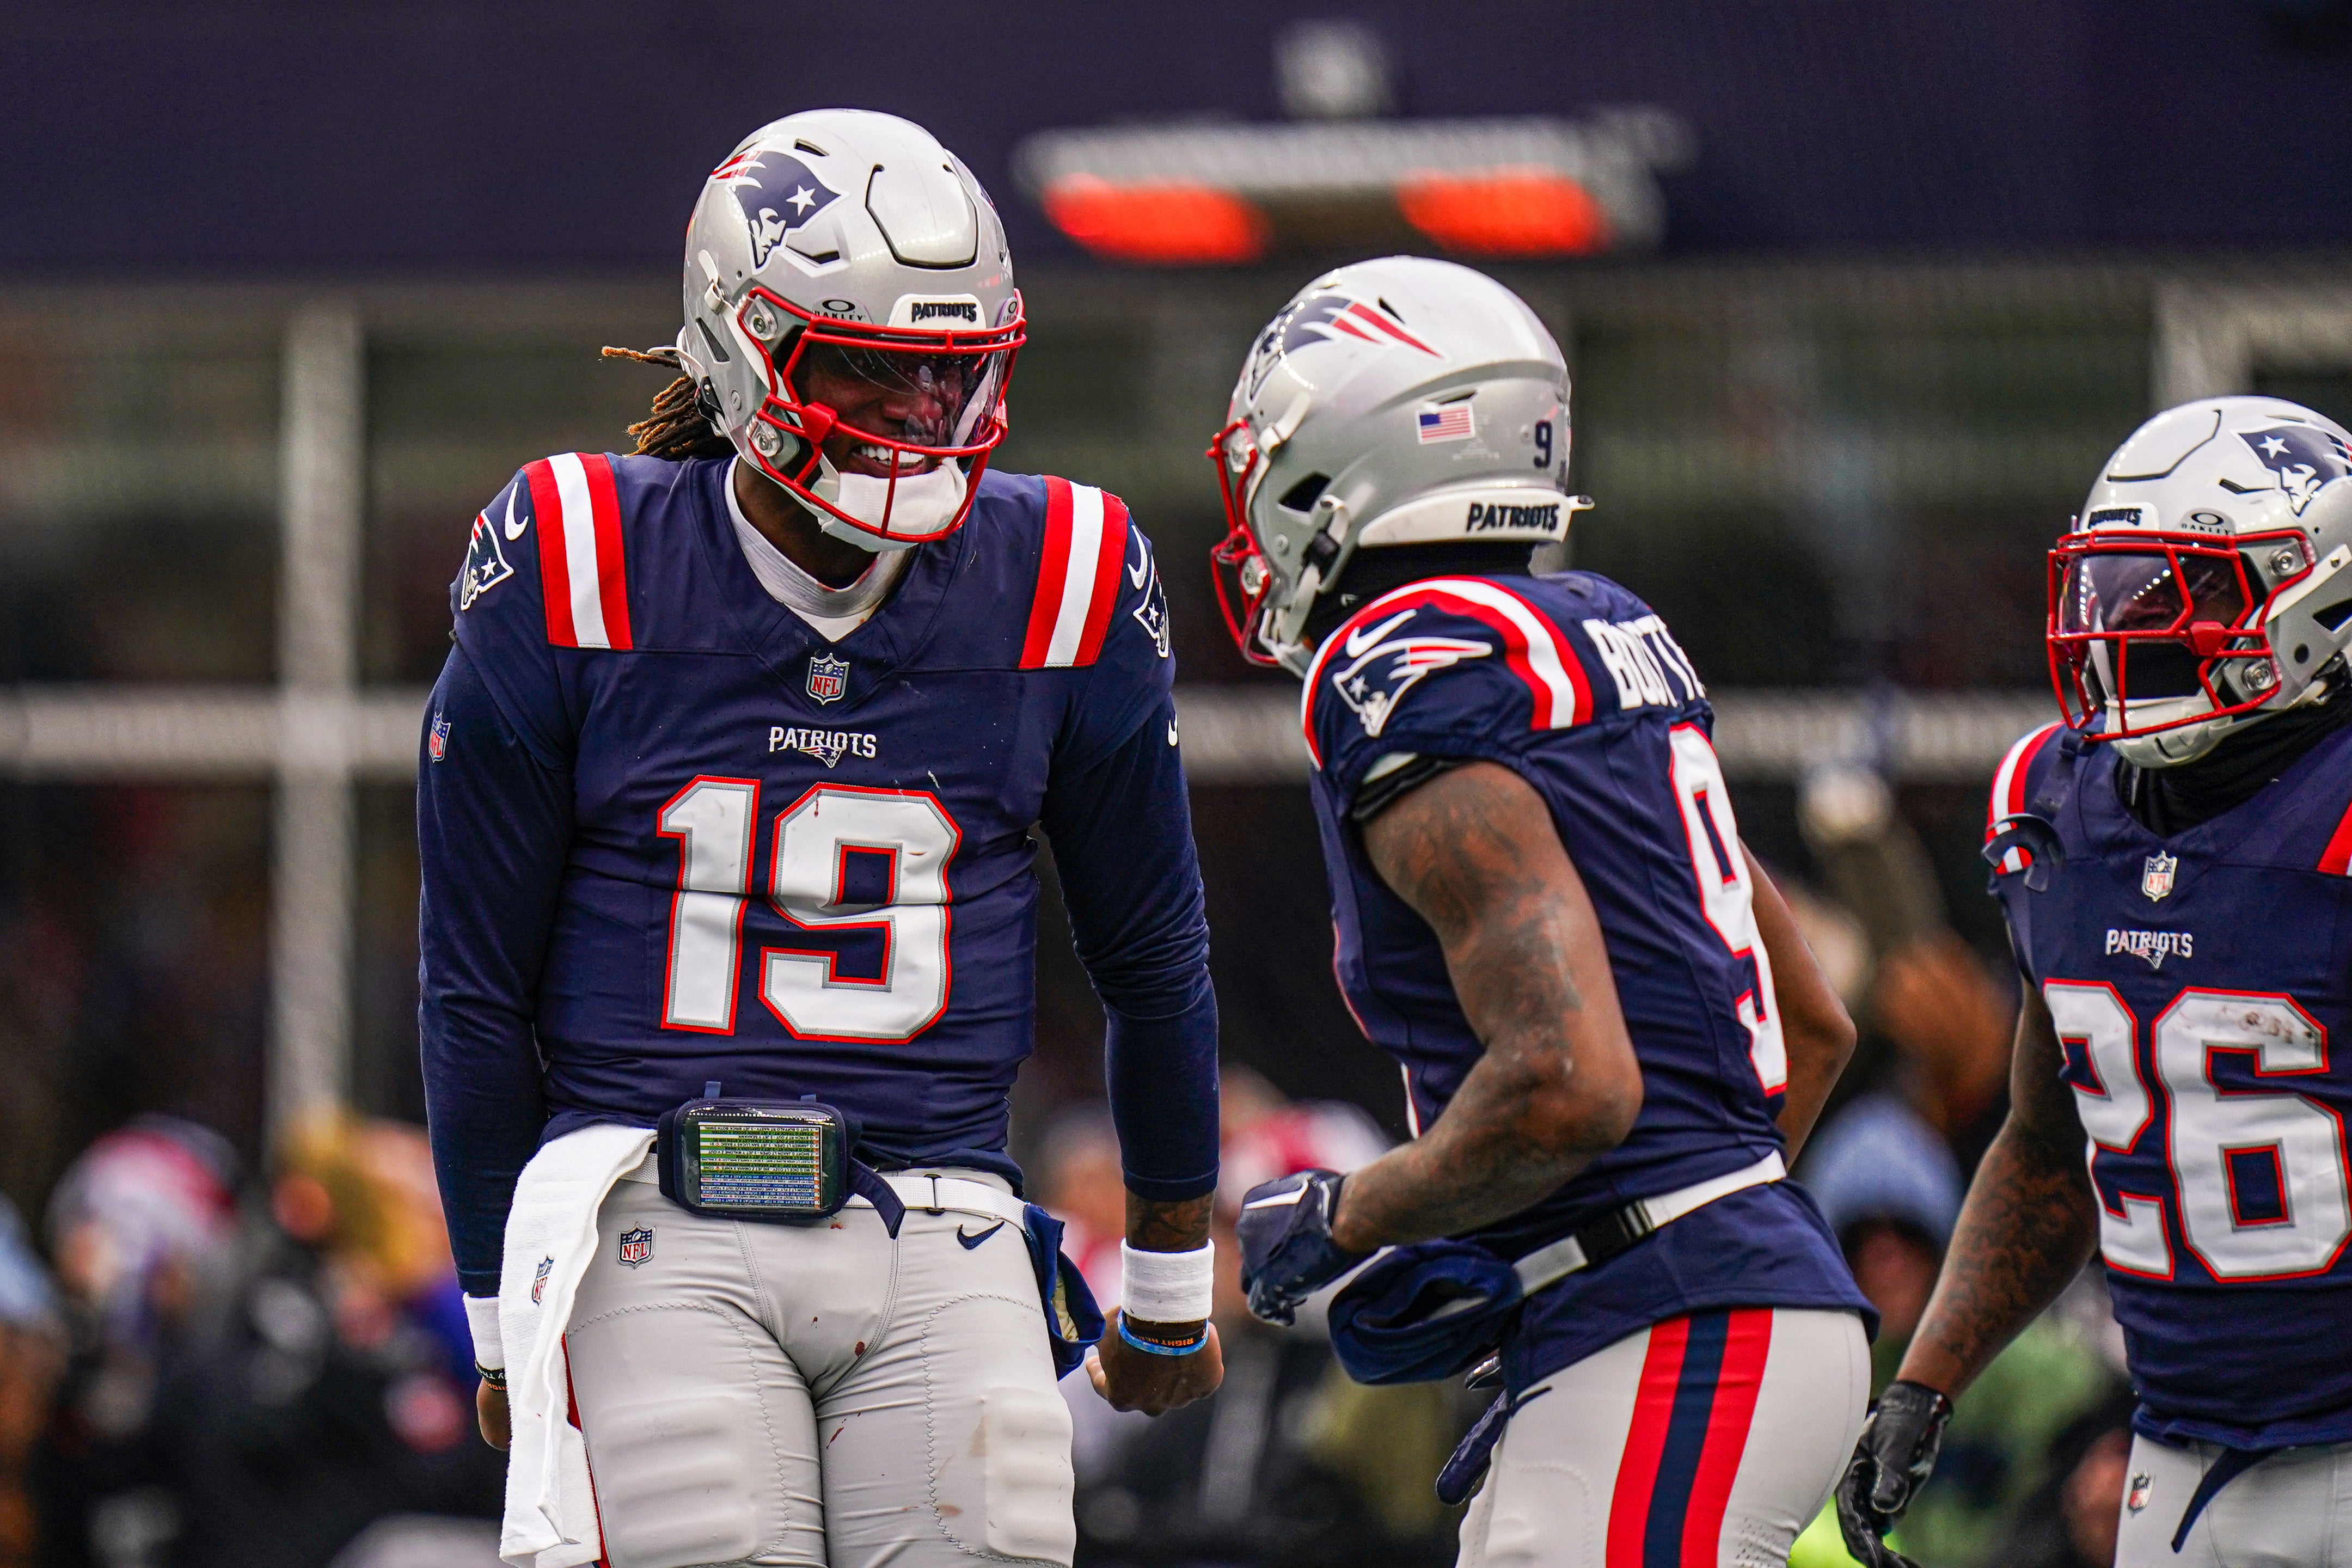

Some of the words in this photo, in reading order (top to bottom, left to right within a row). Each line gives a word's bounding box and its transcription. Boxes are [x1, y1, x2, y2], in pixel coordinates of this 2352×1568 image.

[911, 303, 977, 322] PATRIOTS
[1534, 420, 1552, 469] 9
[1466, 502, 1559, 531] PATRIOTS
[812, 676, 839, 696] NFL
[769, 726, 877, 758] PATRIOTS
[2148, 874, 2168, 893] NFL
[657, 775, 963, 1044] 19
[1668, 721, 1787, 1095] 9
[2105, 928, 2194, 958] PATRIOTS
[2044, 978, 2352, 1283] 26
[623, 1243, 647, 1260] NFL
[1161, 1338, 1194, 1346] RIGHT
